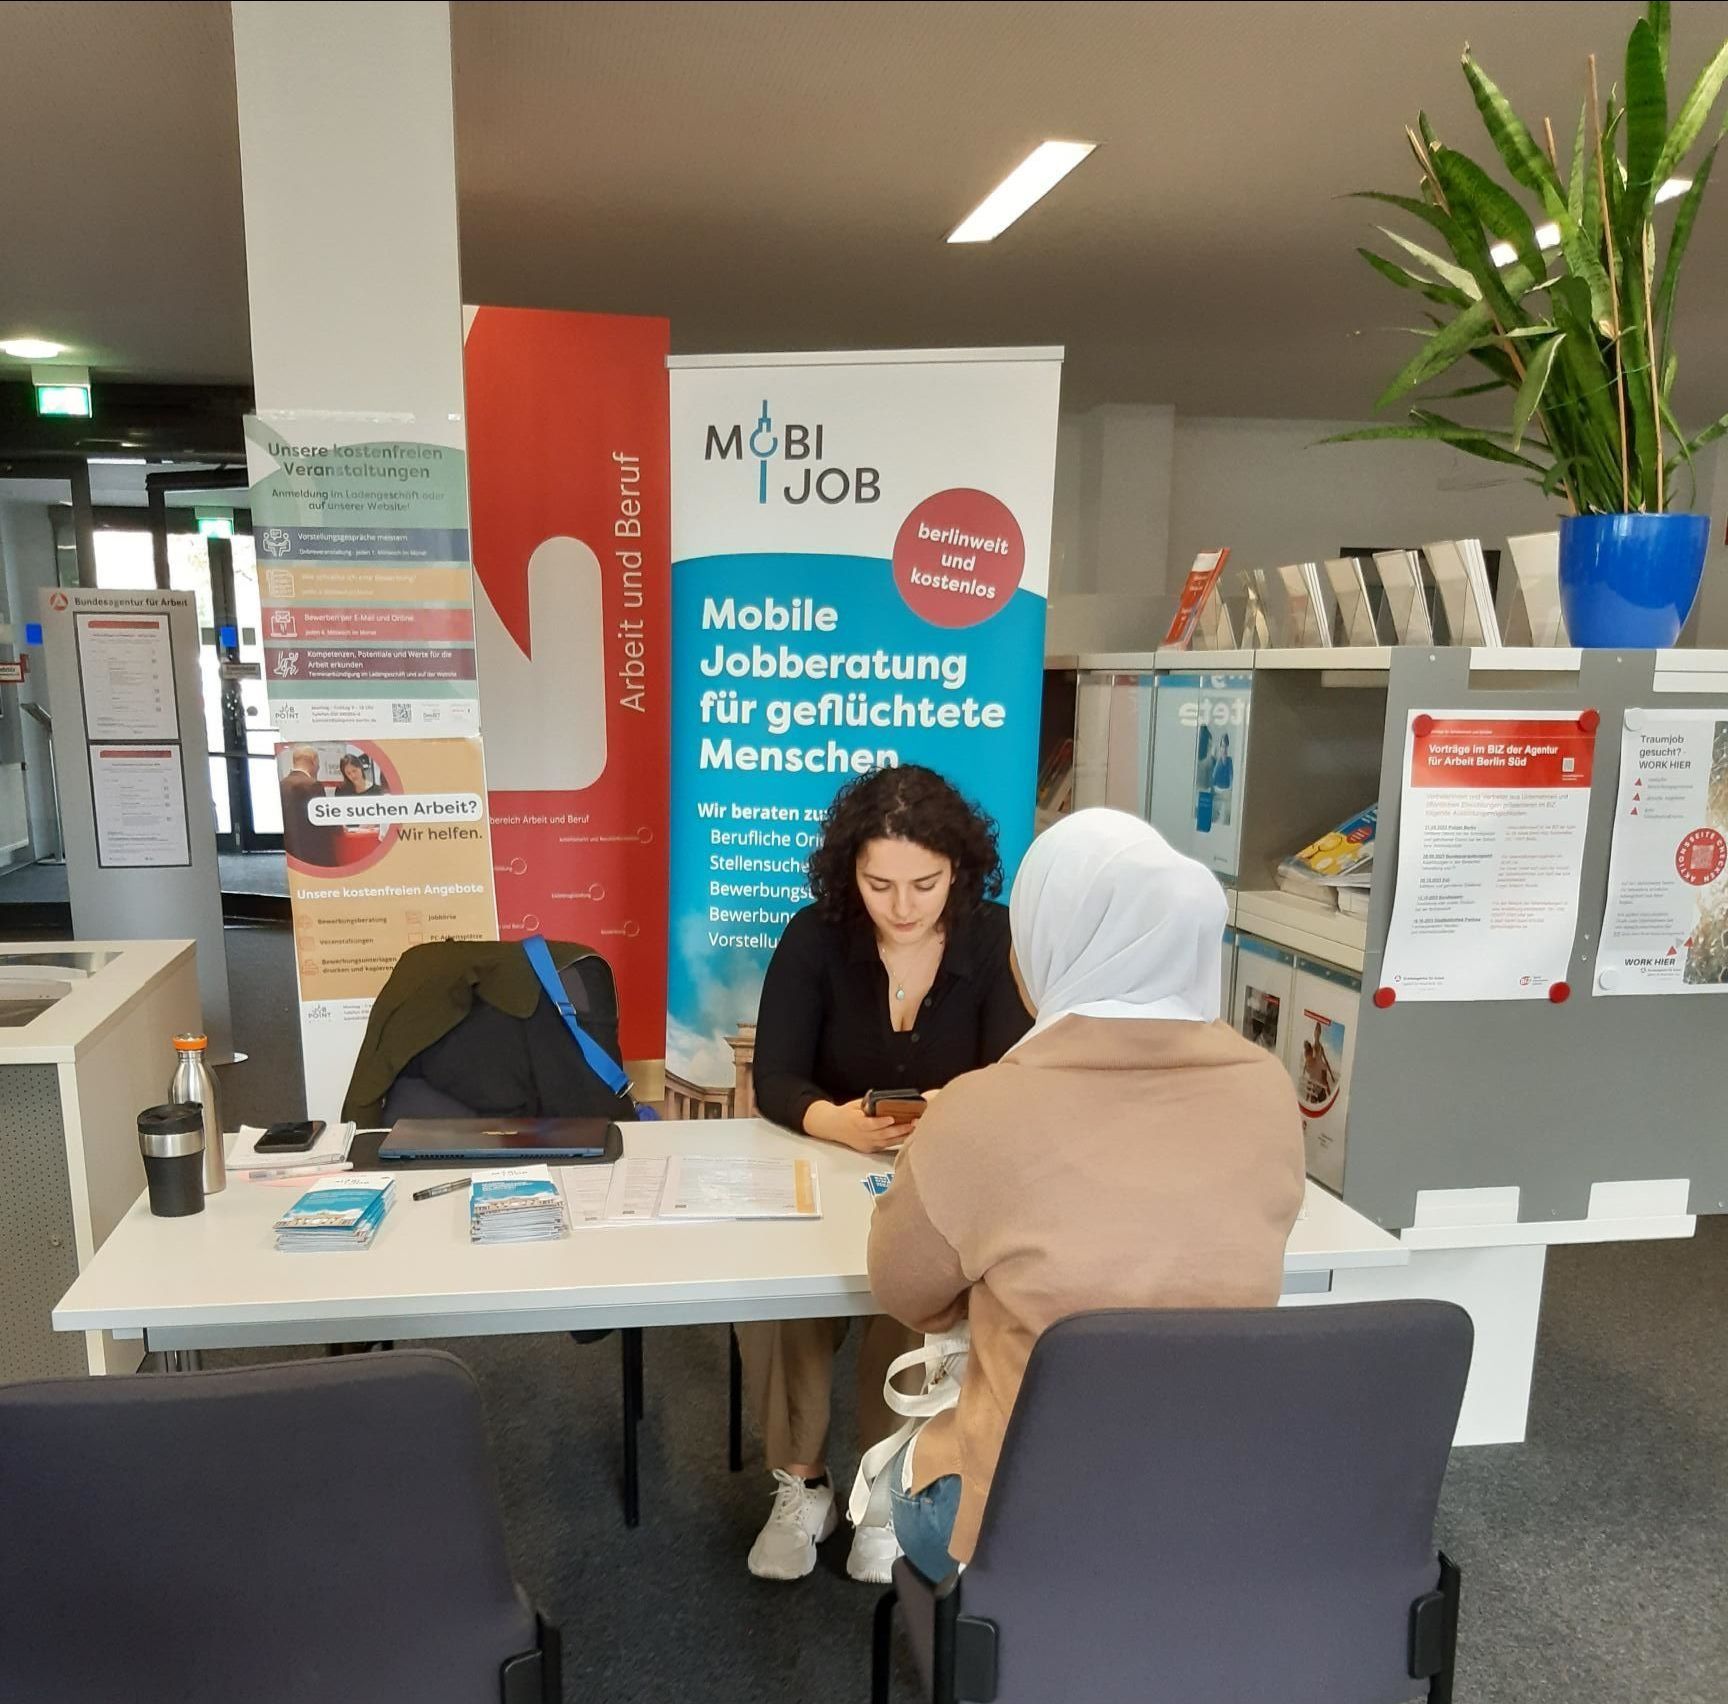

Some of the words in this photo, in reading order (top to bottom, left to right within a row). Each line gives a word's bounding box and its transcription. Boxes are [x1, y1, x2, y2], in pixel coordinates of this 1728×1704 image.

[268, 443, 328, 457] Unsere
[333, 444, 442, 460] kostenfreien
[284, 462, 430, 482] Veranstaltungen
[612, 451, 641, 537] Beruf
[784, 467, 881, 504] JOB
[272, 489, 329, 501] Anmeldung
[308, 502, 326, 510] auf
[328, 503, 364, 511] unserer
[918, 523, 1008, 555] berlinweit
[941, 552, 976, 572] und
[616, 550, 643, 607] und
[911, 568, 997, 600] kostenlos
[74, 597, 143, 608] Bundesagentur
[146, 598, 158, 606] für
[161, 597, 188, 607] Arbeit
[702, 597, 839, 632] Mobile
[308, 661, 329, 669] Arbeit
[330, 661, 364, 669] erkunden
[618, 619, 645, 712] Arbeit
[700, 645, 967, 690] Jobberatung
[700, 690, 757, 724] für
[766, 693, 1006, 735] geflüchtete
[1640, 735, 1685, 745] Traumjob
[700, 738, 899, 773] Menschen
[1429, 743, 1470, 756] Vorträge
[1472, 744, 1485, 754] im
[1507, 744, 1522, 754] der
[1524, 745, 1559, 757] Agentur
[1639, 748, 1682, 759] gesucht?
[1428, 756, 1441, 766] für
[1444, 756, 1474, 766] Arbeit
[1476, 756, 1506, 766] Berlin
[1507, 756, 1527, 766] Süd
[1638, 760, 1668, 769] WORK
[1669, 760, 1692, 769] HIER
[315, 803, 341, 818] Sie
[346, 803, 408, 818] suchen
[414, 800, 477, 815] Arbeit?
[697, 802, 727, 818] Wir
[731, 803, 799, 821] beraten
[522, 814, 547, 825] Arbeit
[549, 815, 565, 824] und
[567, 813, 590, 824] Beruf
[397, 828, 423, 841] Wir
[428, 827, 483, 841] helfen.
[710, 829, 791, 847] Berufliche
[709, 855, 810, 873] Stellensuche
[297, 888, 341, 900] Unsere
[343, 885, 421, 898] kostenfreien
[423, 883, 485, 898] Angebote
[708, 932, 780, 949] Vorstellu
[1624, 958, 1653, 966] WORK
[1654, 958, 1676, 966] HIER
